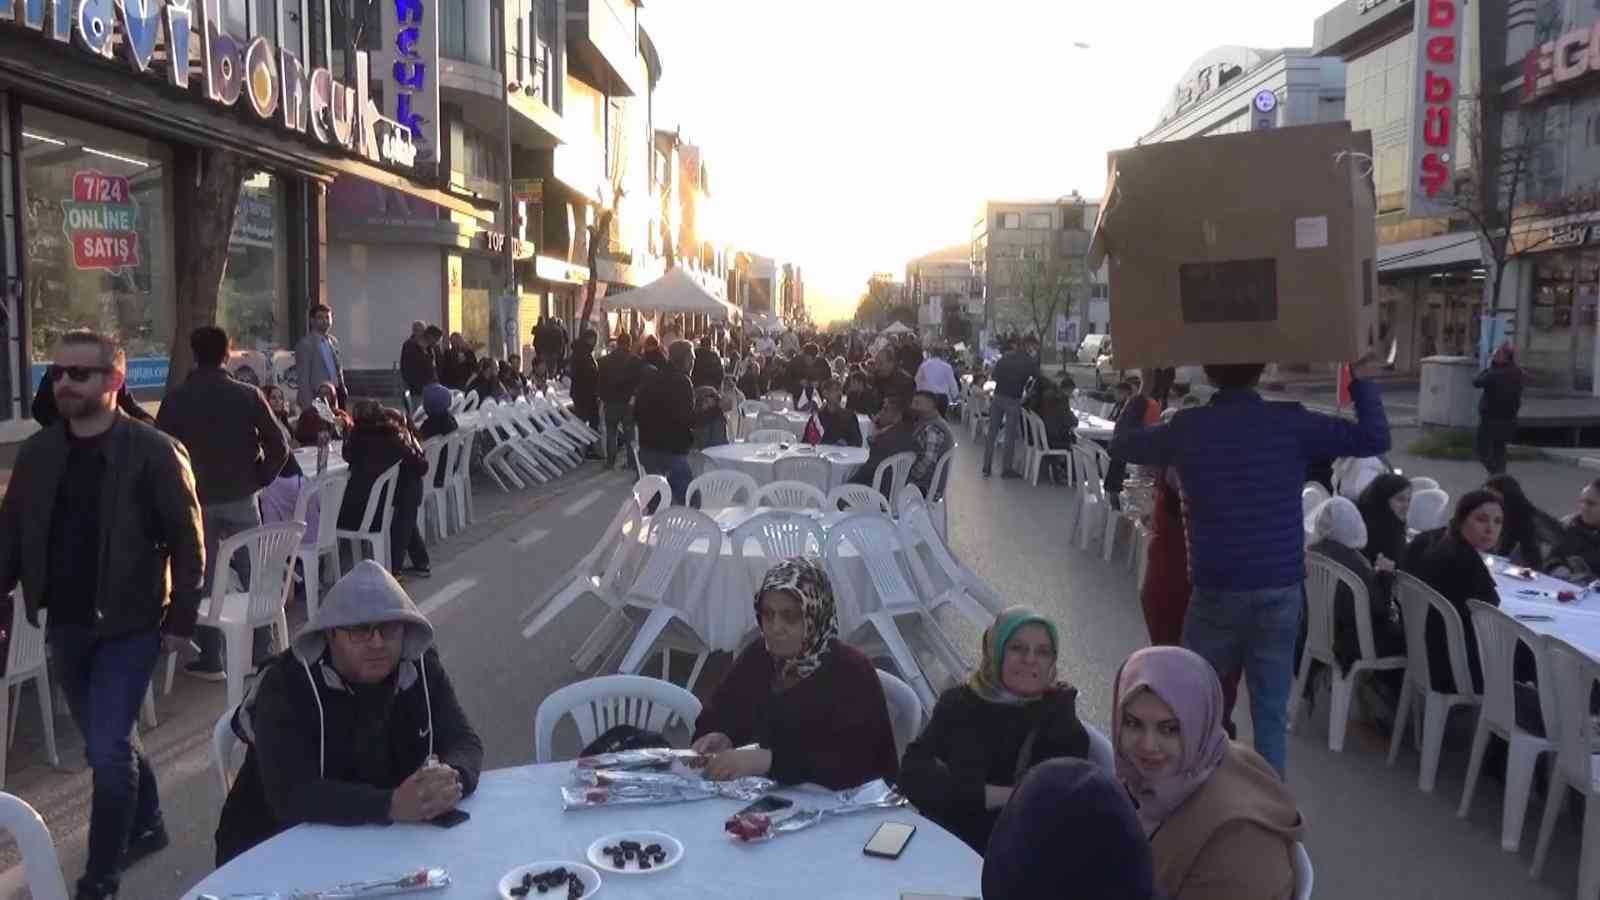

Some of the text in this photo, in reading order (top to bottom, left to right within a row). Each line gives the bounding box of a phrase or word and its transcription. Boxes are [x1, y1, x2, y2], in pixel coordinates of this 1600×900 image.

[83, 177, 122, 202] 7/24
[68, 208, 129, 229] ONLİNE
[83, 237, 129, 262] SATIŞ
[487, 230, 506, 252] TOP
